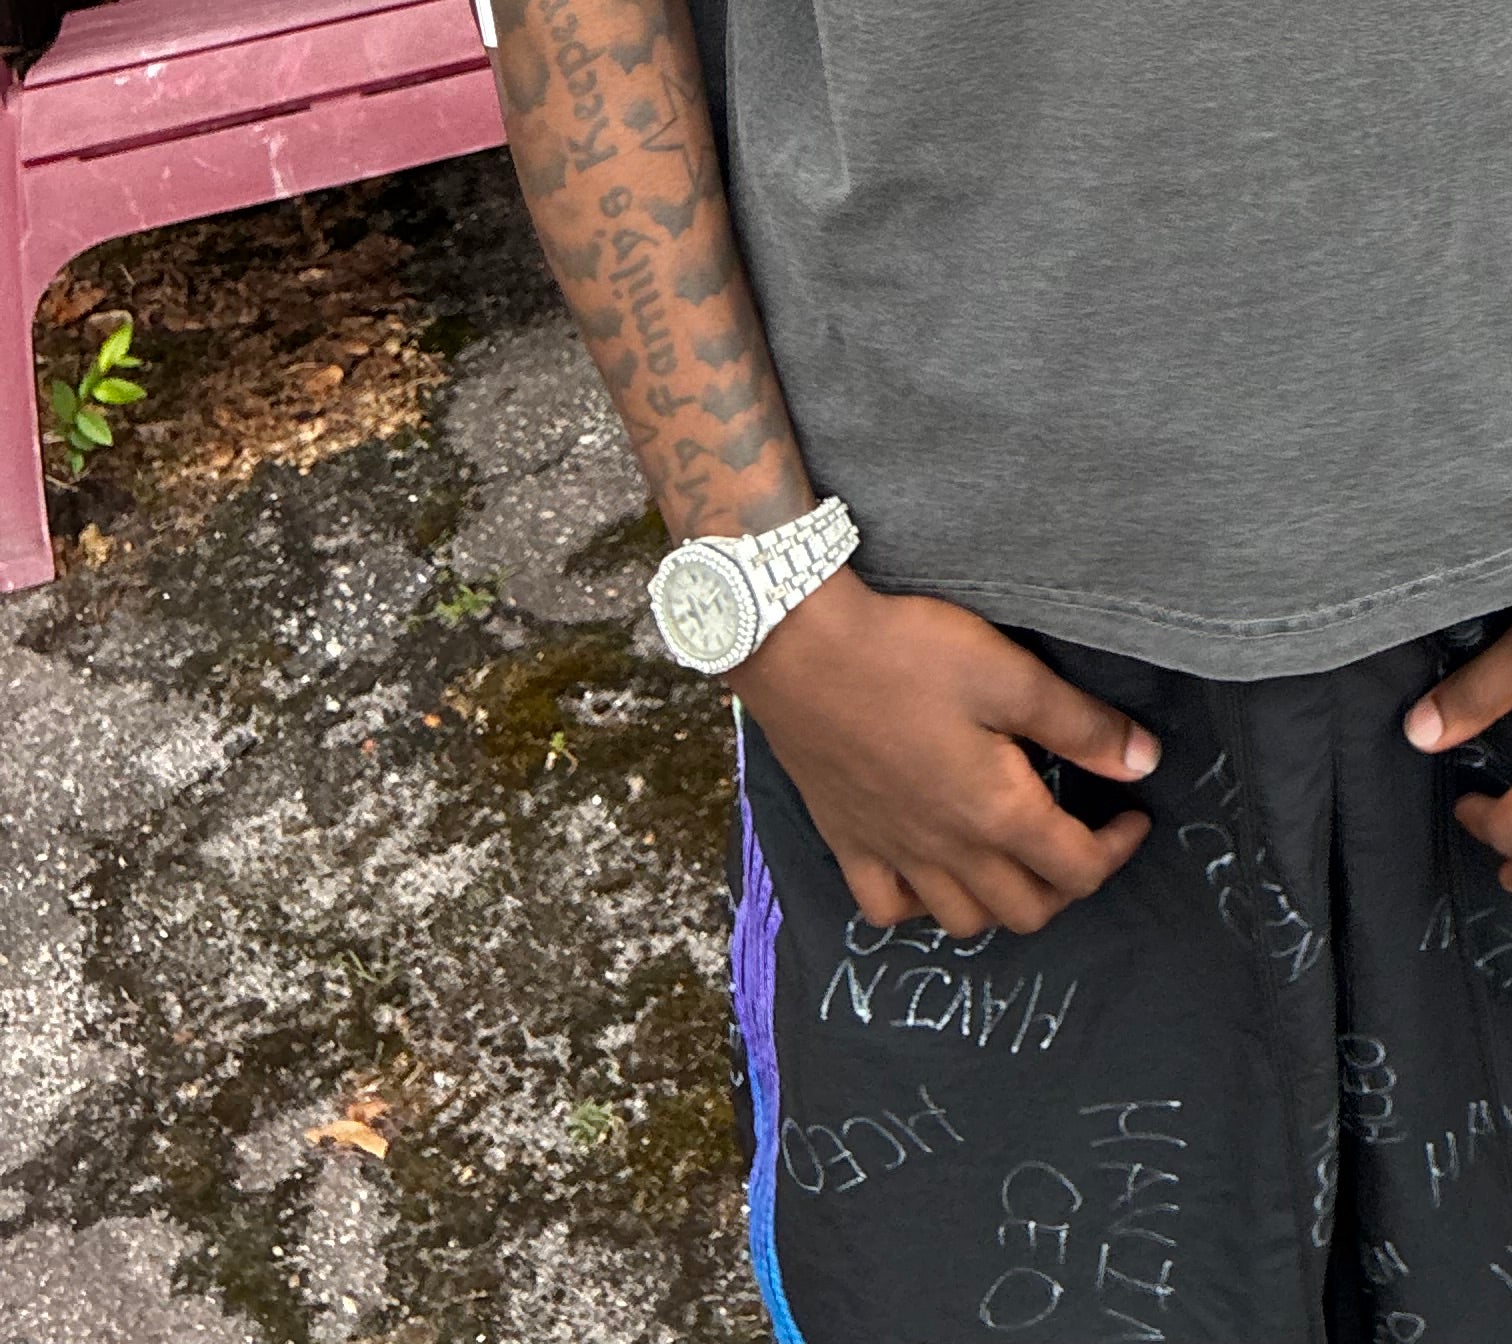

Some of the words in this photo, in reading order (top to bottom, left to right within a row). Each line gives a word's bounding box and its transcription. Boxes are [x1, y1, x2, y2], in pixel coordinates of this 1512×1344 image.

[820, 957, 1079, 1055] HAVIN
[780, 1084, 965, 1194] HCEO
[1338, 1034, 1409, 1145] HCEO
[978, 1159, 1083, 1330] CEO
